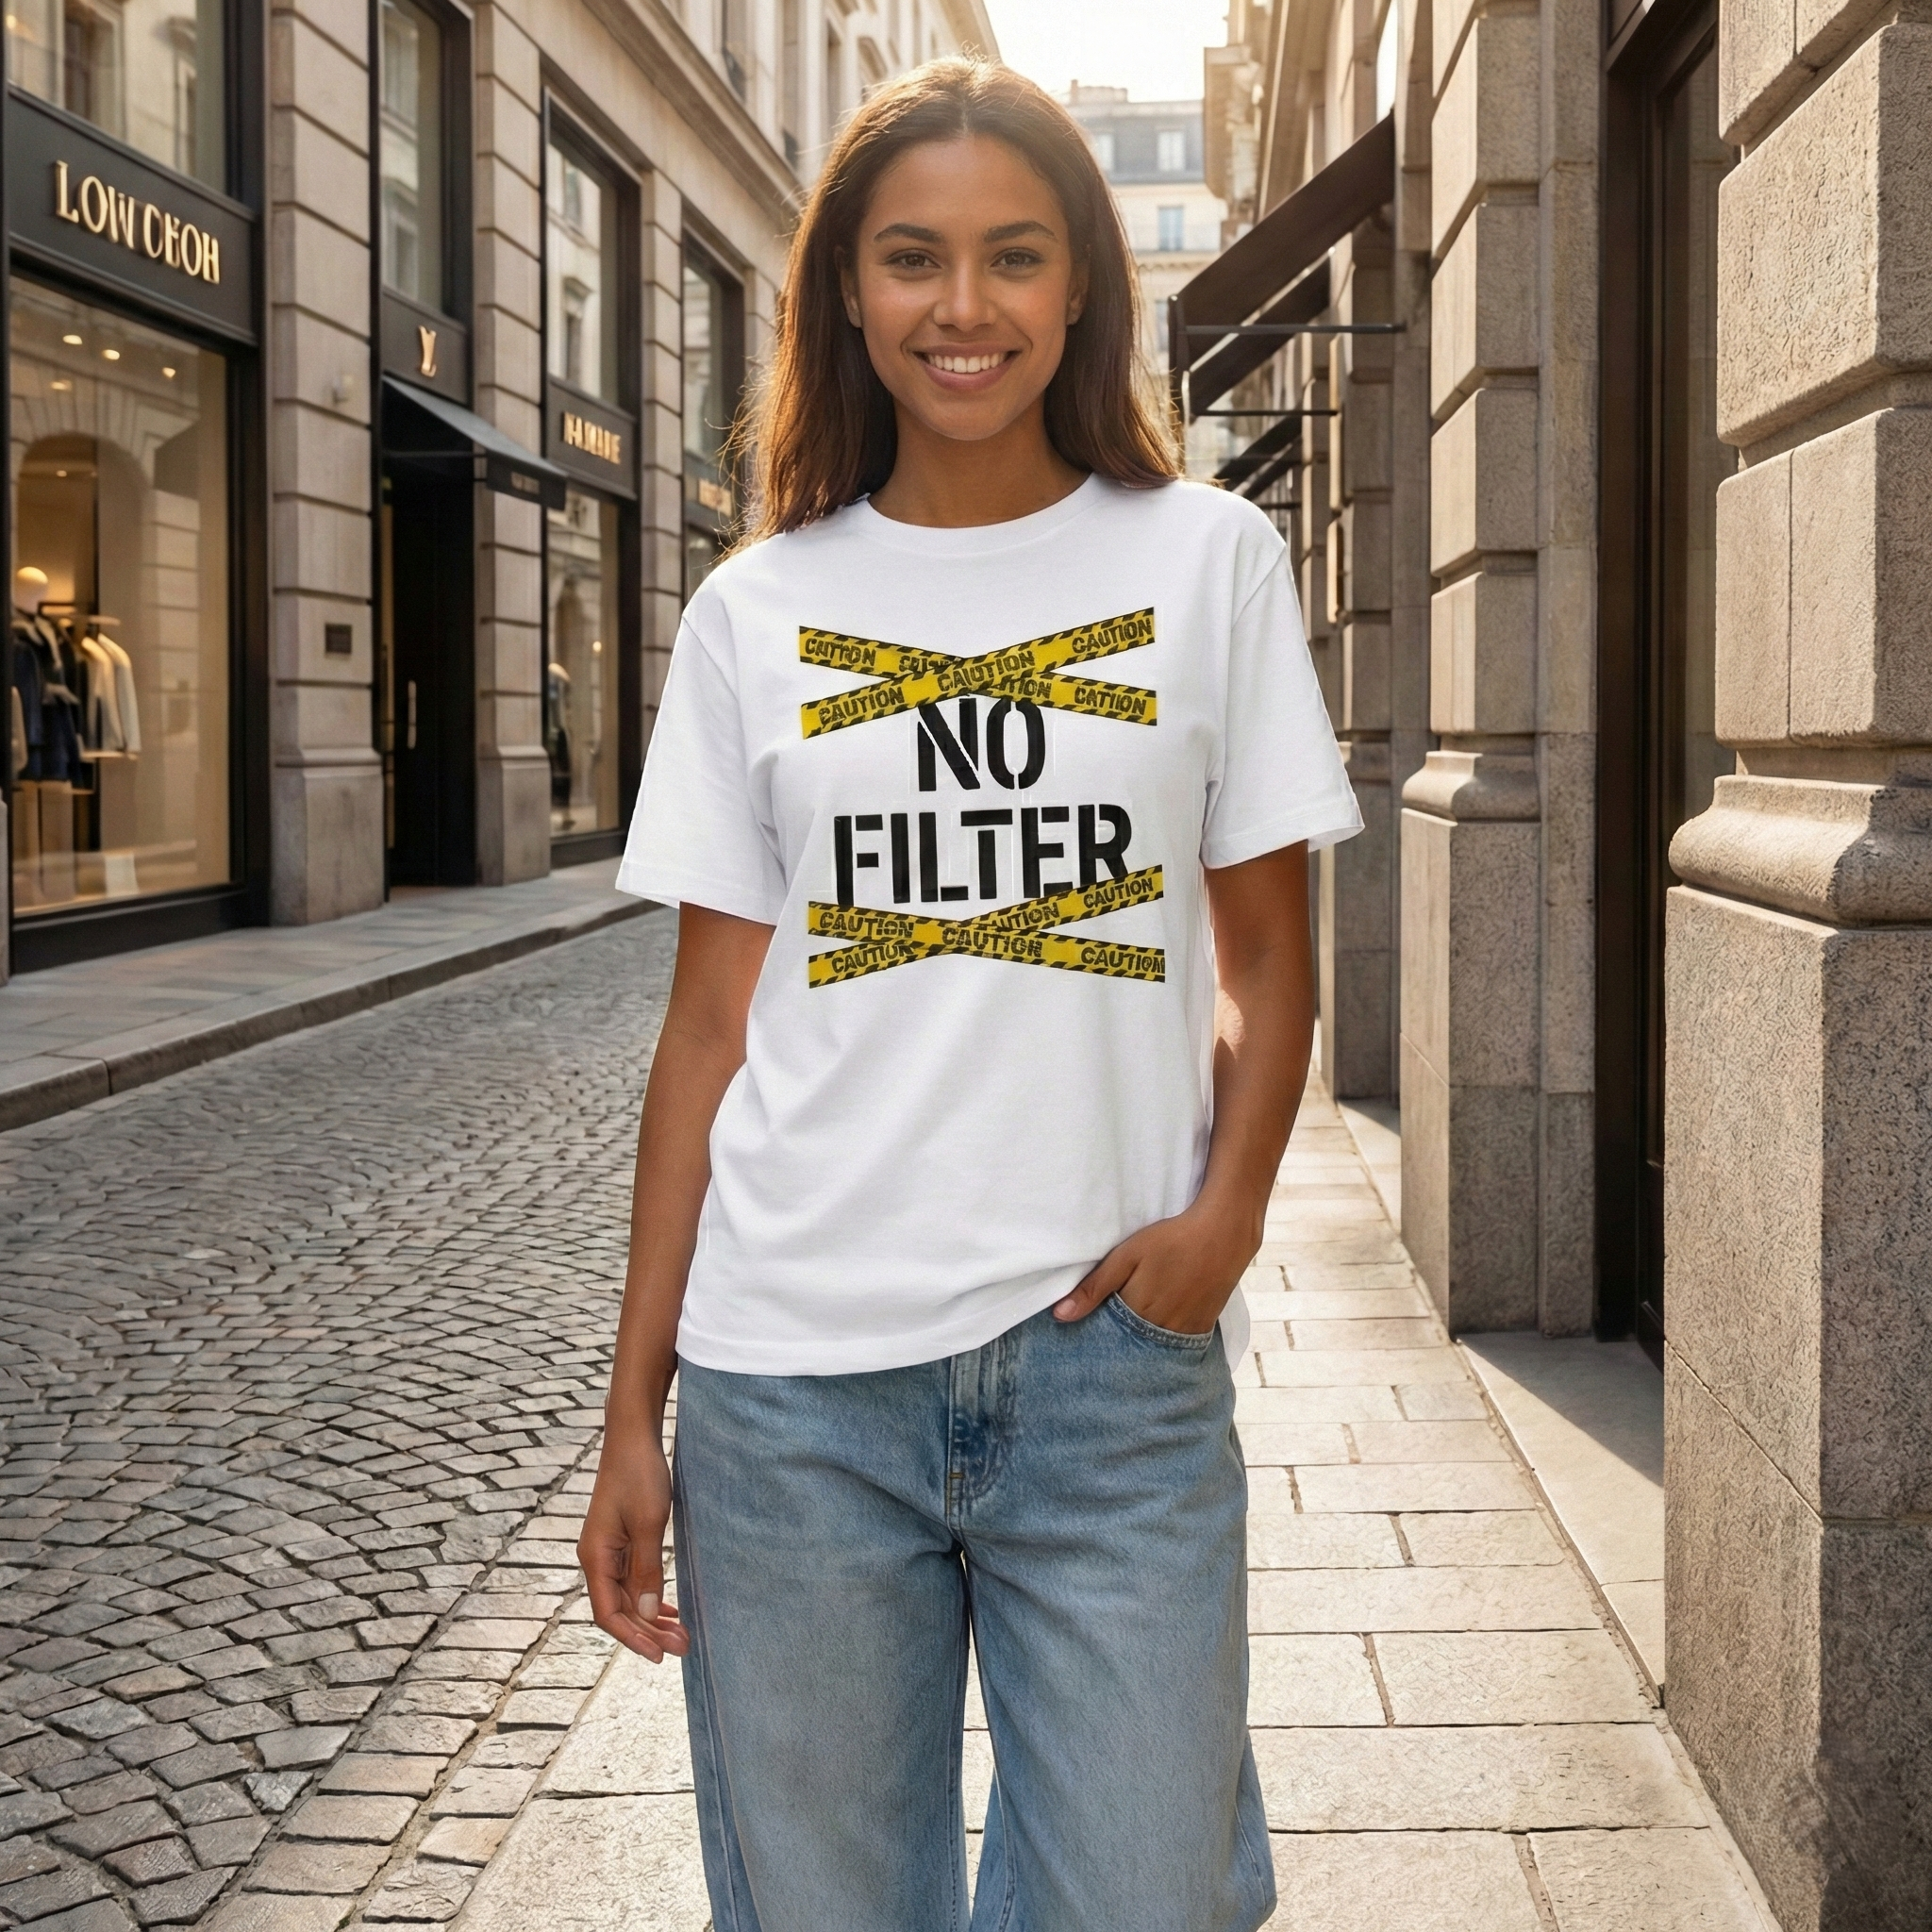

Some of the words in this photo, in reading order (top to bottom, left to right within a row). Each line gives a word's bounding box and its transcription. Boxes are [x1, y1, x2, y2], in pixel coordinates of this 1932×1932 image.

[1072, 618, 1152, 654] CAUTION
[917, 697, 1046, 792] NO
[835, 803, 1132, 908] FILTER
[1083, 878, 1154, 908] CAUTION
